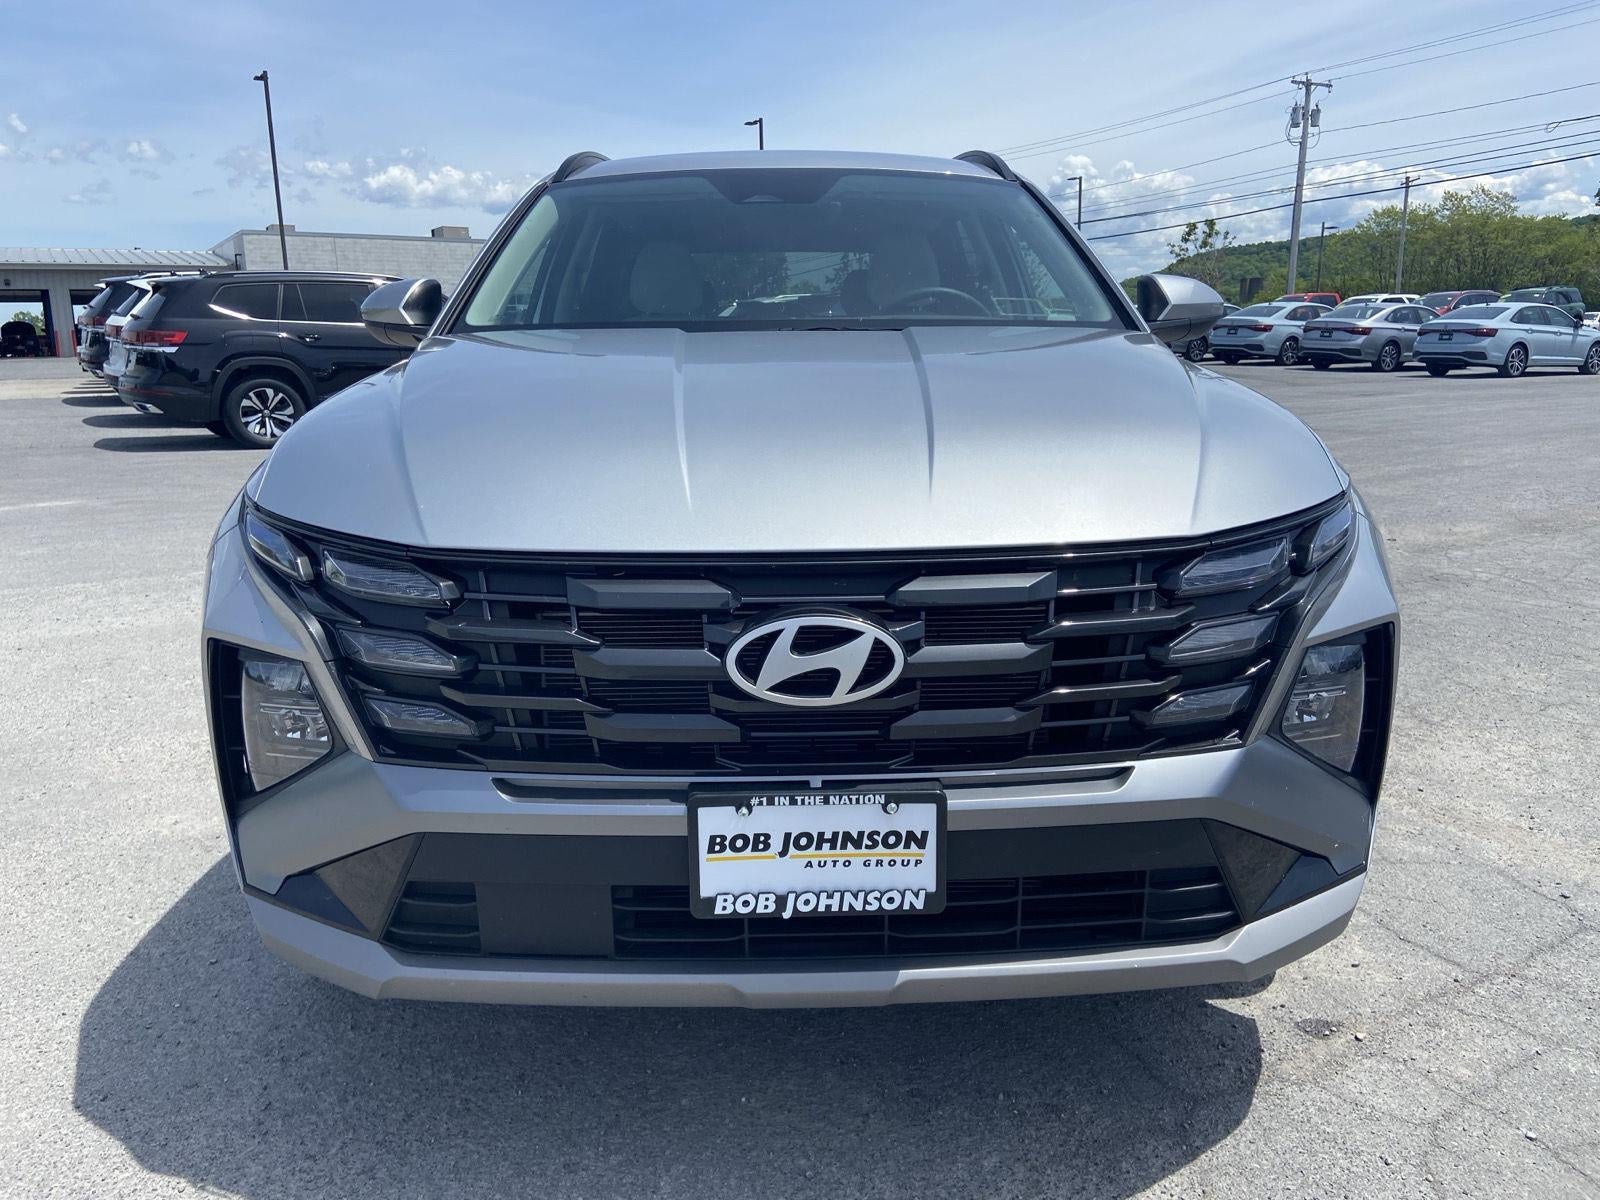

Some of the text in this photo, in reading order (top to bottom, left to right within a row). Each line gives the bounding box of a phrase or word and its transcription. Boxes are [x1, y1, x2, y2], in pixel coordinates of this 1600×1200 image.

[750, 794, 885, 806] #1 IN THE NATION
[707, 830, 929, 858] BOB JOHNSON
[804, 859, 923, 868] AUTO GROUP
[714, 889, 925, 919] BOB JOHNSON
